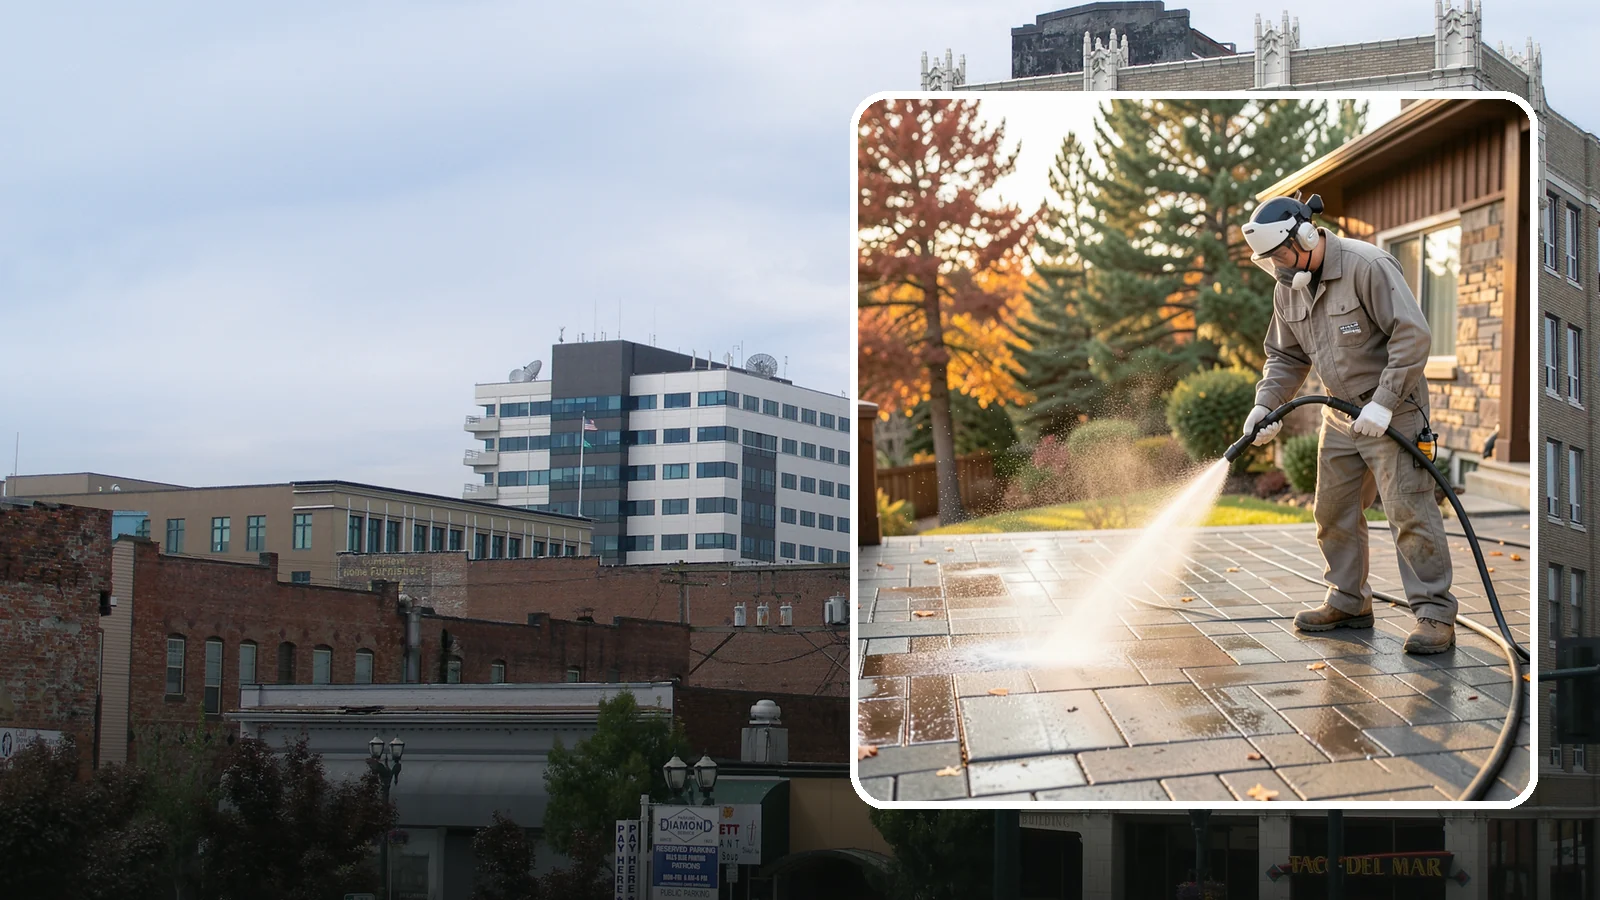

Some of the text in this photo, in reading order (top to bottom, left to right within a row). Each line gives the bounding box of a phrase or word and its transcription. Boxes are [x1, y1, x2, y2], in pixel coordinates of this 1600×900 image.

[370, 566, 427, 576] Furnishers
[660, 818, 713, 833] DIAMOND
[1022, 815, 1070, 828] BUILDING
[655, 845, 716, 854] RESERVED PARKING
[616, 824, 625, 894] PAY HERE
[627, 824, 637, 894] PAY HERE
[721, 851, 739, 862] Soup
[671, 861, 701, 870] PATRONS
[1289, 855, 1442, 877] TAC DEL MAR
[660, 888, 710, 898] PUBLIC PARKING
